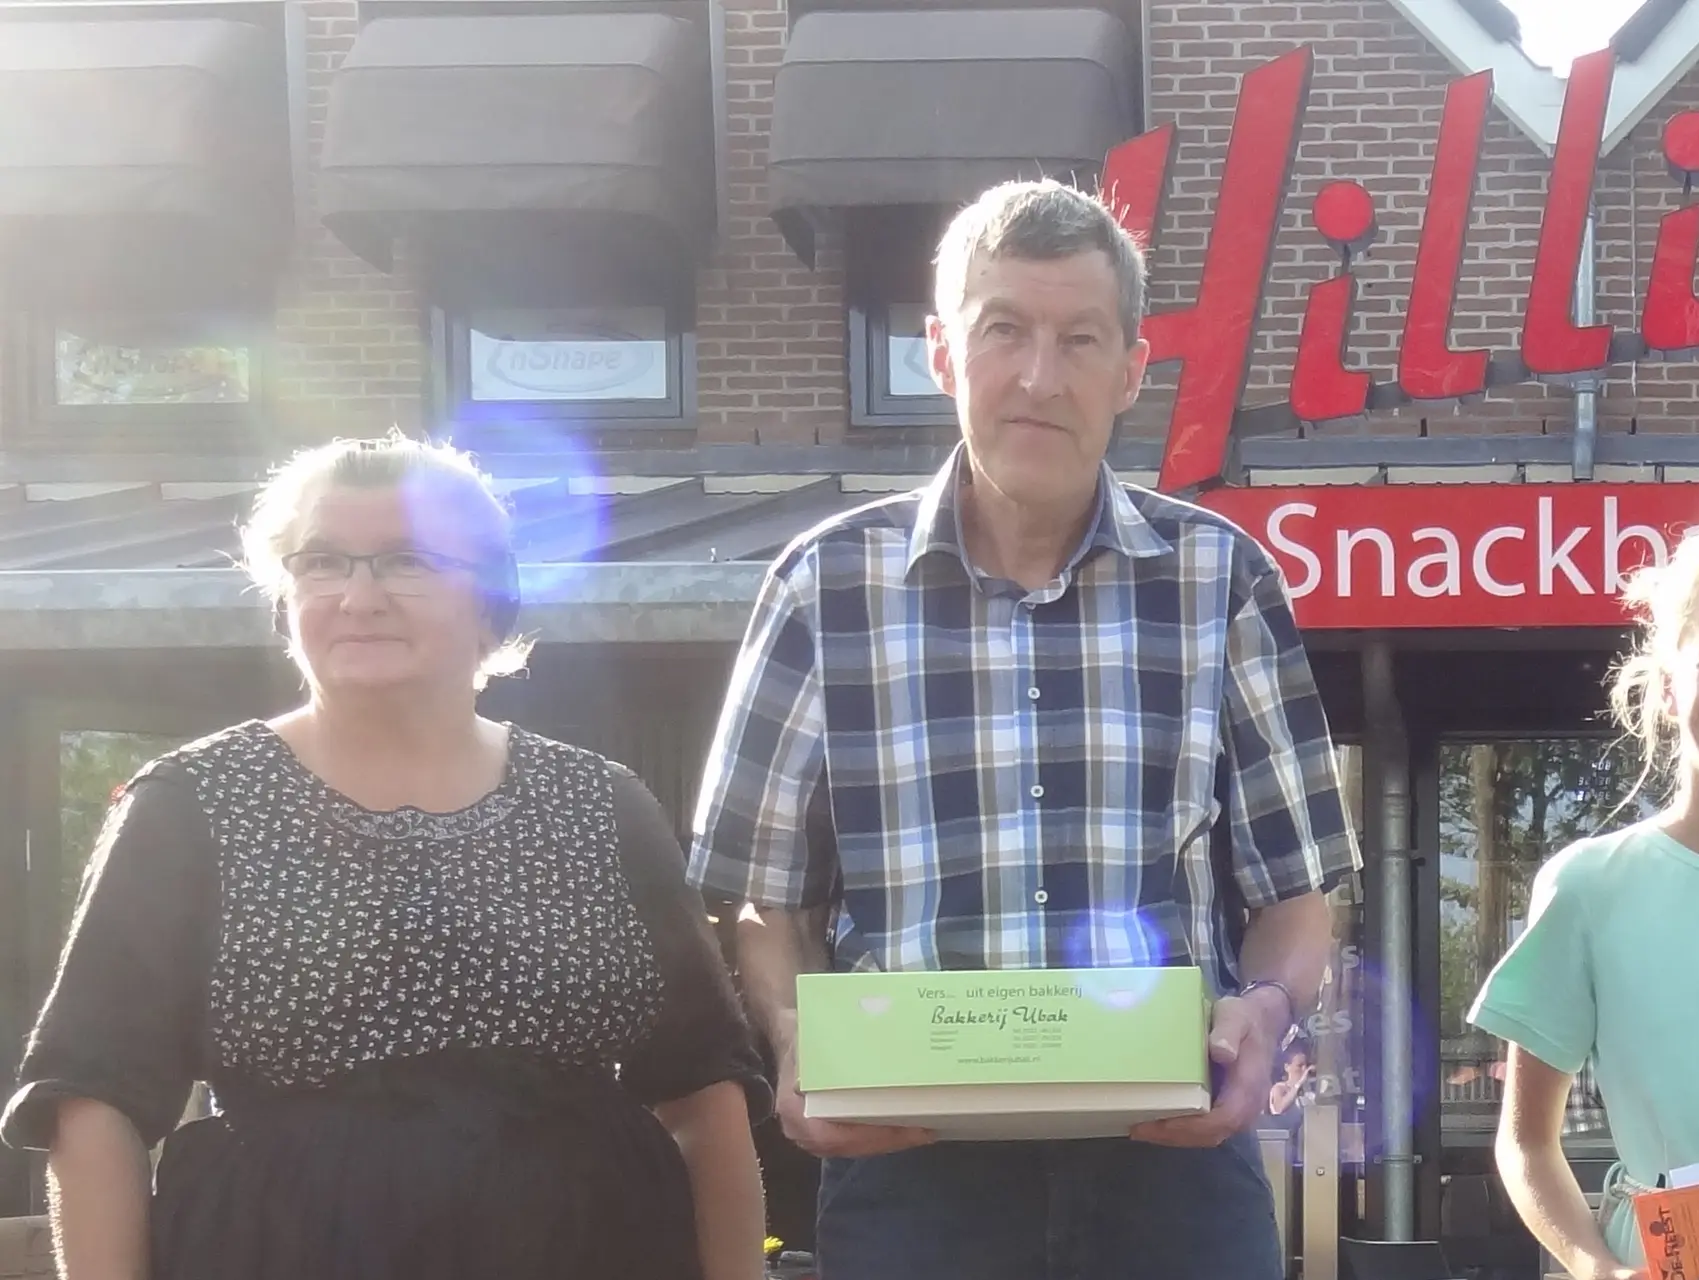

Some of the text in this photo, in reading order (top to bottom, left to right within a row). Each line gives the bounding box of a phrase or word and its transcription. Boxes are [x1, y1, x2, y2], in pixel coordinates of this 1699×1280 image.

[1266, 495, 1698, 599] Snackb
[966, 986, 984, 998] uit
[987, 985, 1026, 1000] eigen
[1029, 984, 1083, 999] bakkerij
[930, 1005, 1069, 1030] Bakkerij Ubak
